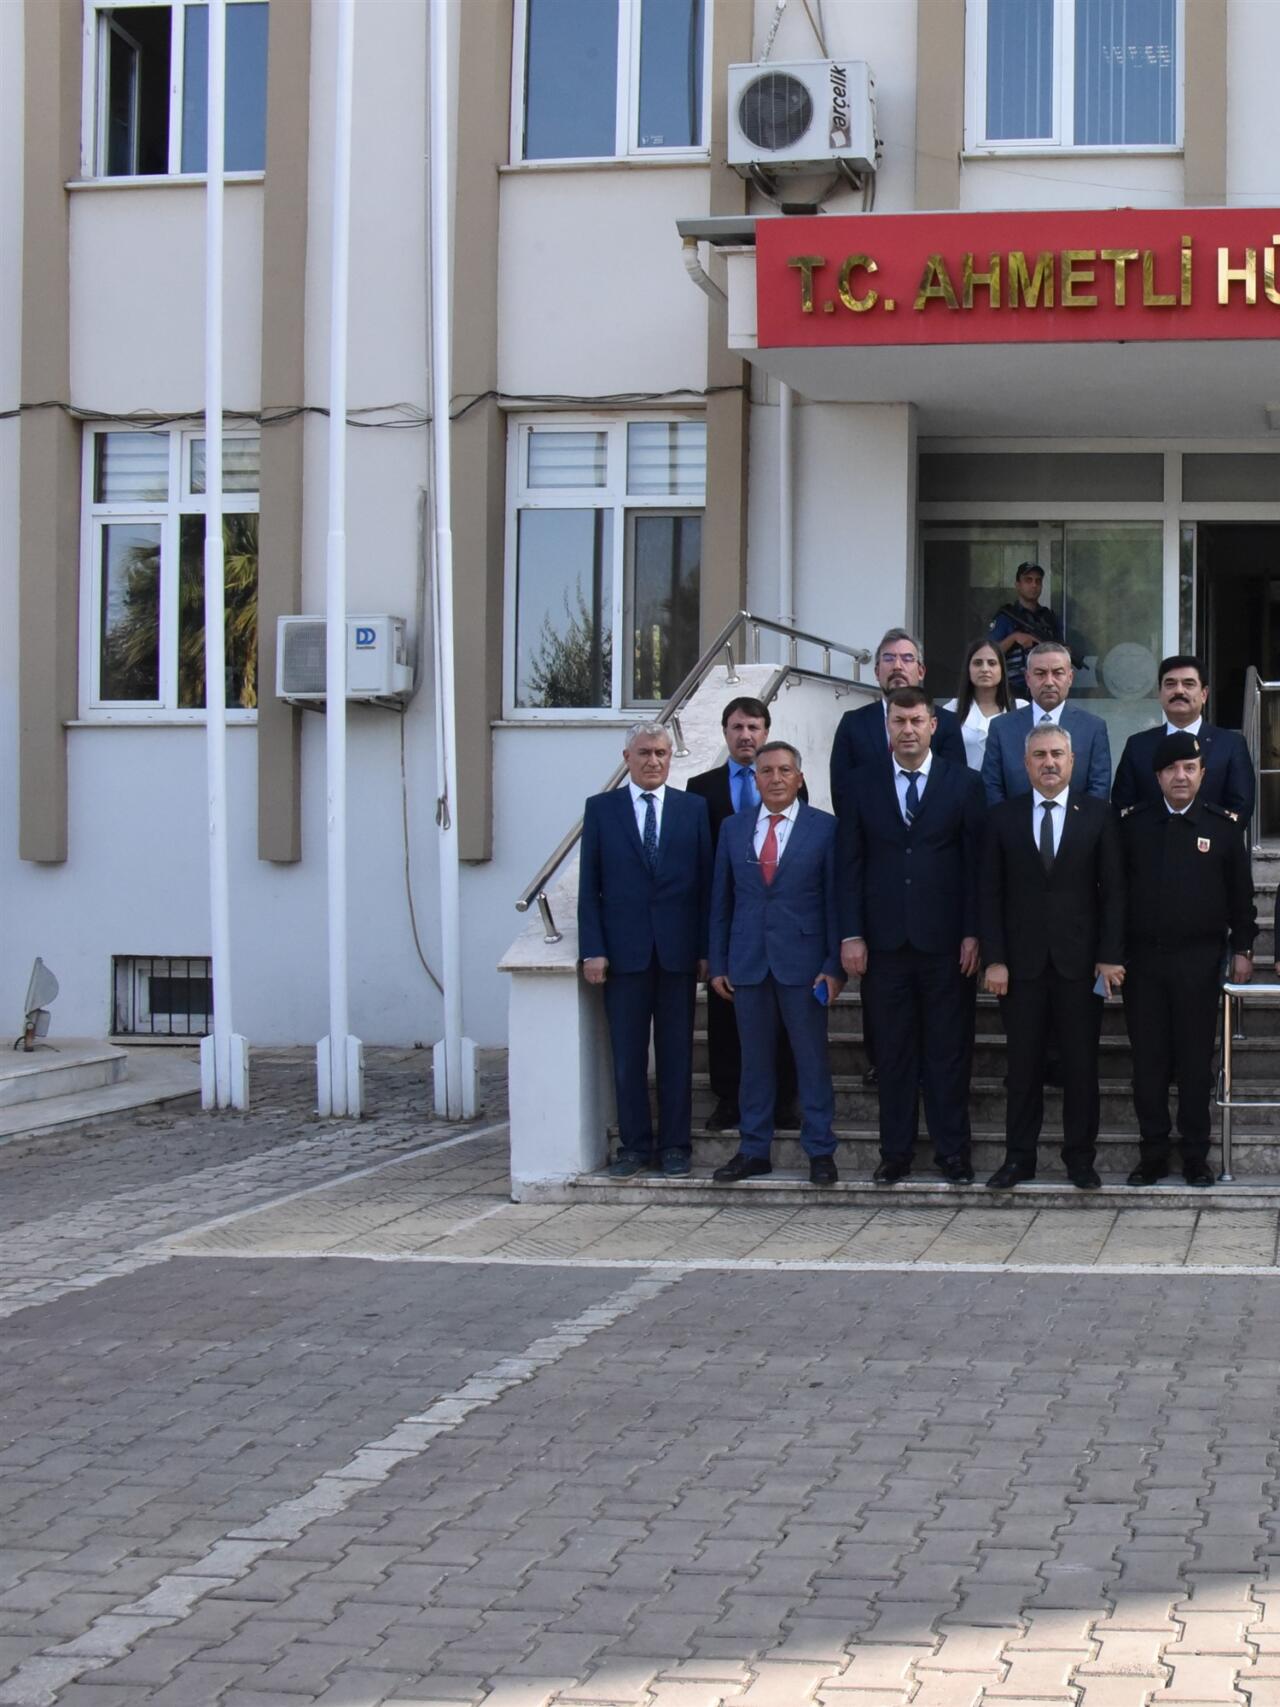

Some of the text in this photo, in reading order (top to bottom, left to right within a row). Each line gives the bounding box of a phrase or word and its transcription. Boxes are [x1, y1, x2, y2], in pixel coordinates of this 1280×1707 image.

[829, 65, 851, 128] arçelik
[787, 254, 896, 313] T.C.
[912, 235, 1194, 311] AHMETLİ
